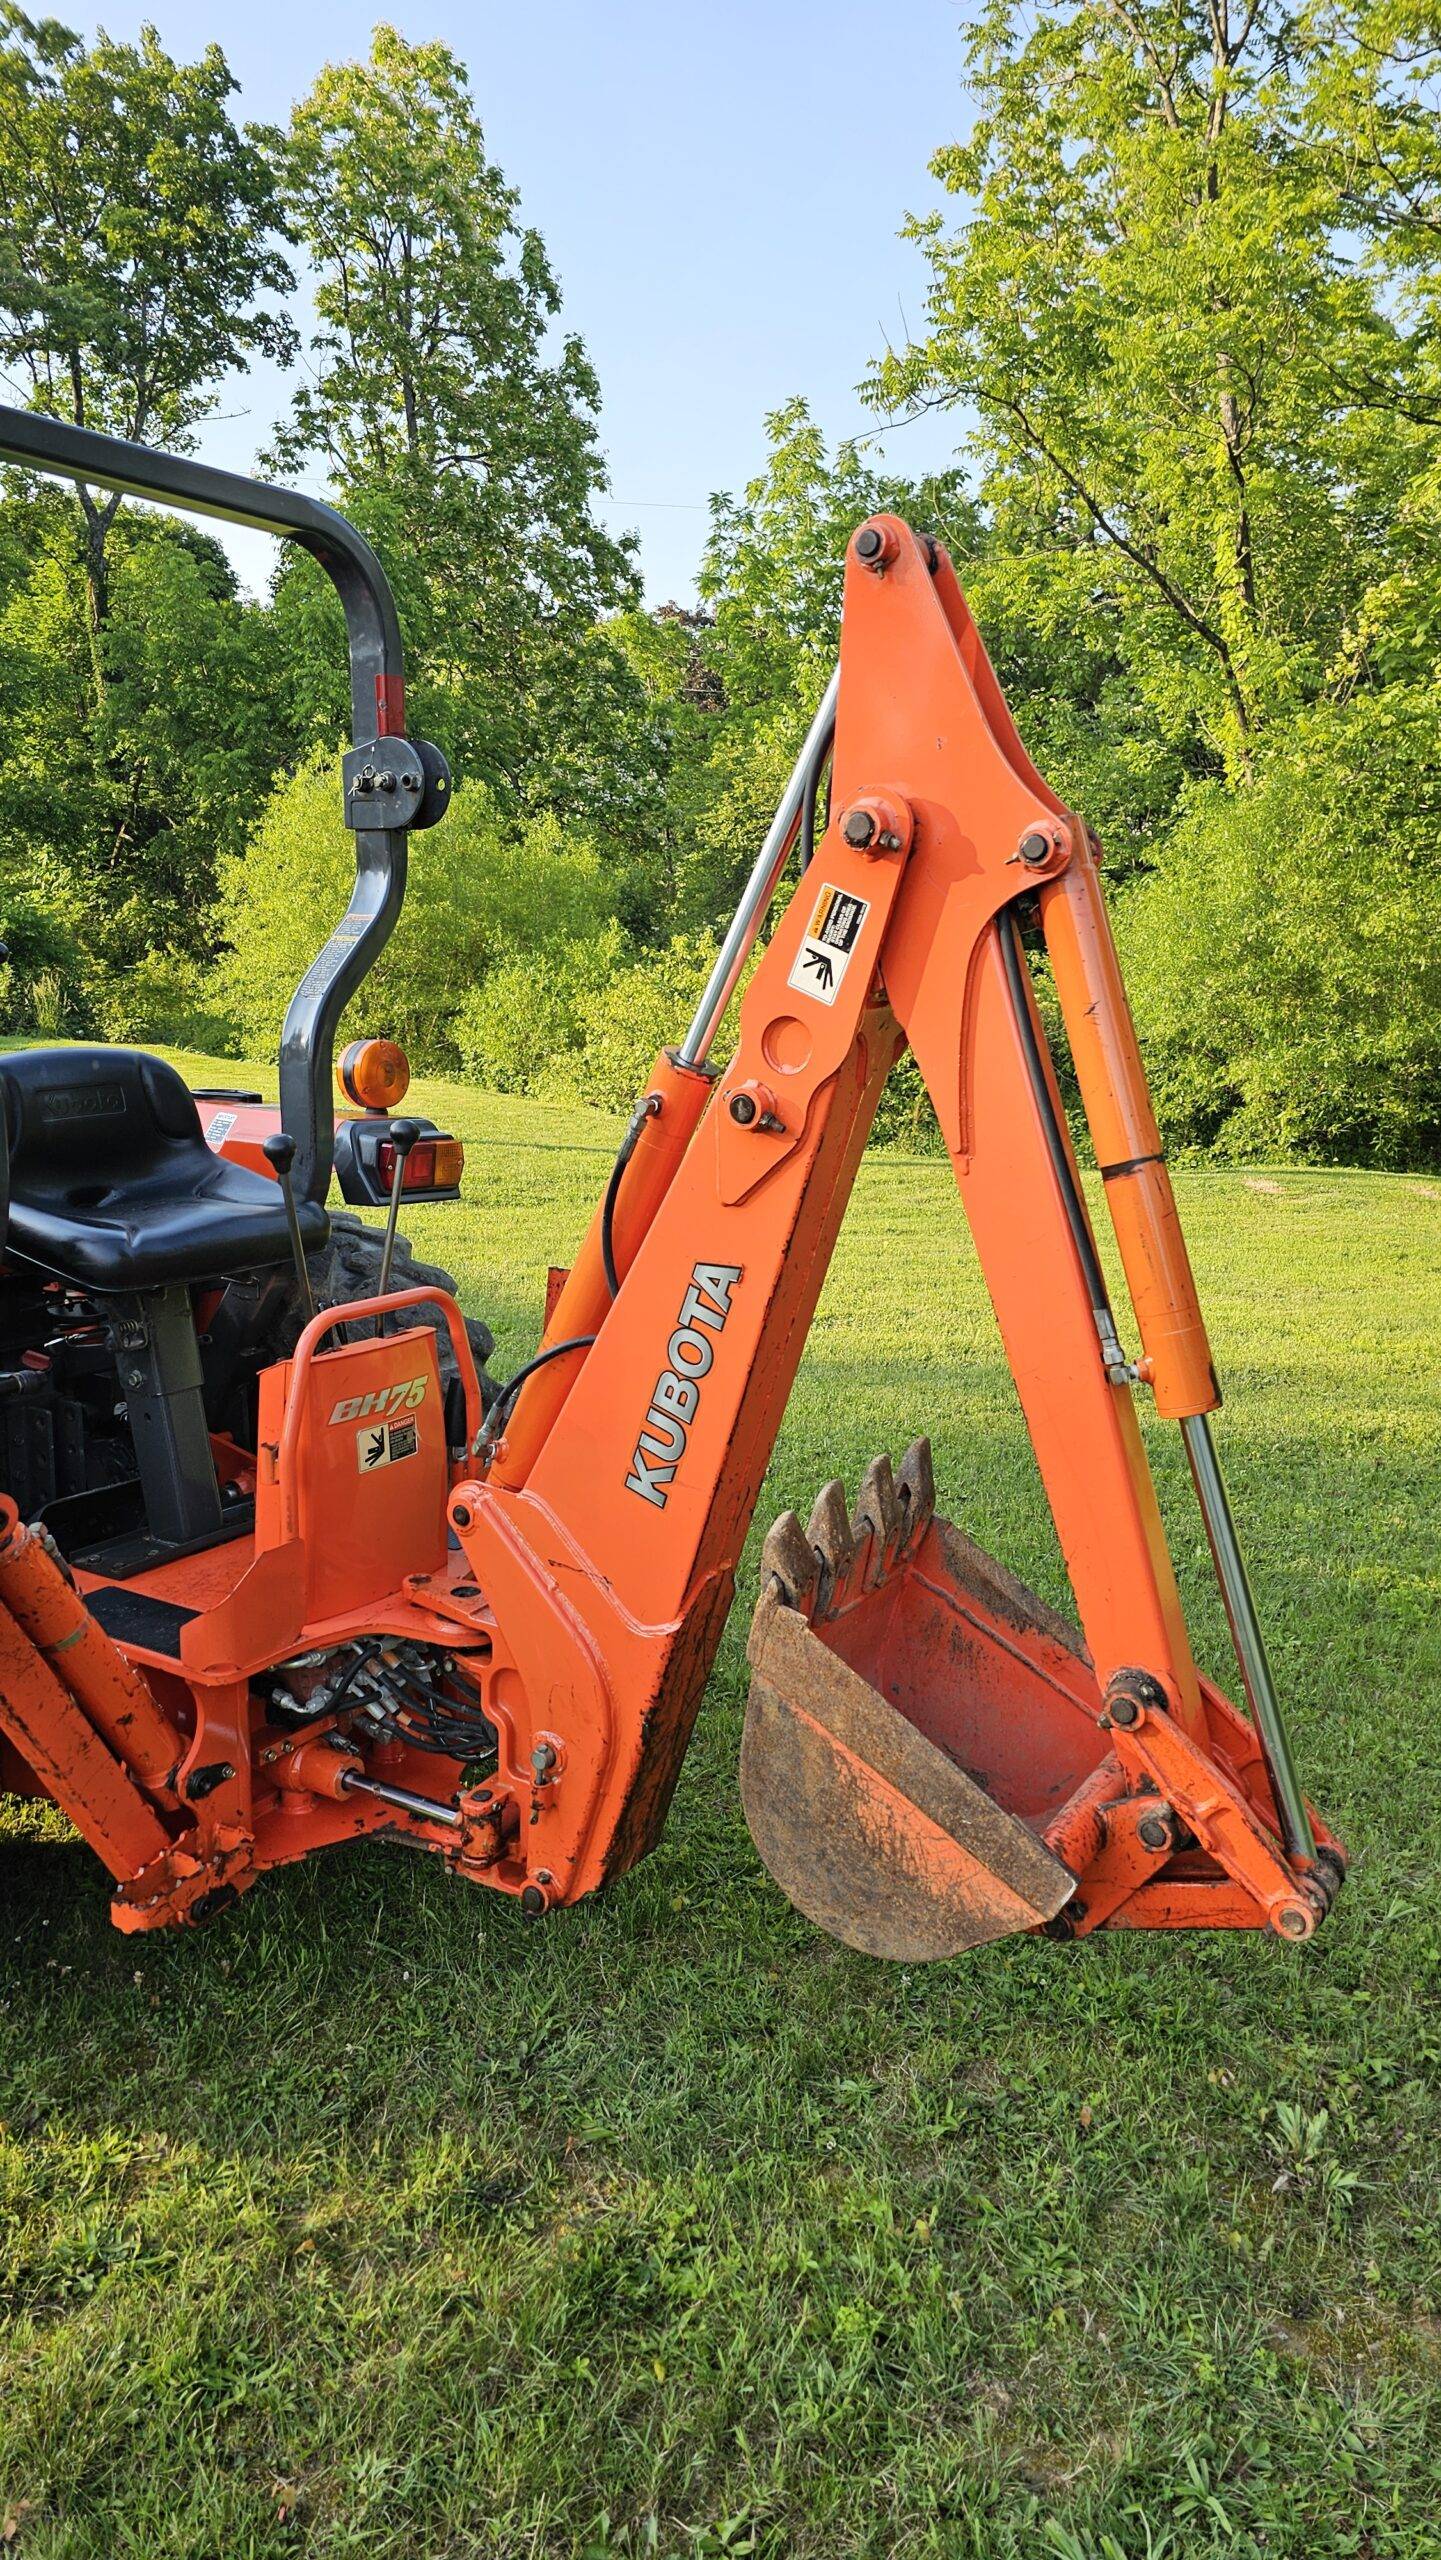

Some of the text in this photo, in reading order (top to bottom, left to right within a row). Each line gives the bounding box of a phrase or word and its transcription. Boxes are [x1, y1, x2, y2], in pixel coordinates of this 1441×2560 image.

[815, 891, 831, 926] WARNING
[328, 1375, 428, 1425] BH75
[625, 1263, 743, 1509] KUBOTA
[394, 1416, 415, 1428] DANGER
